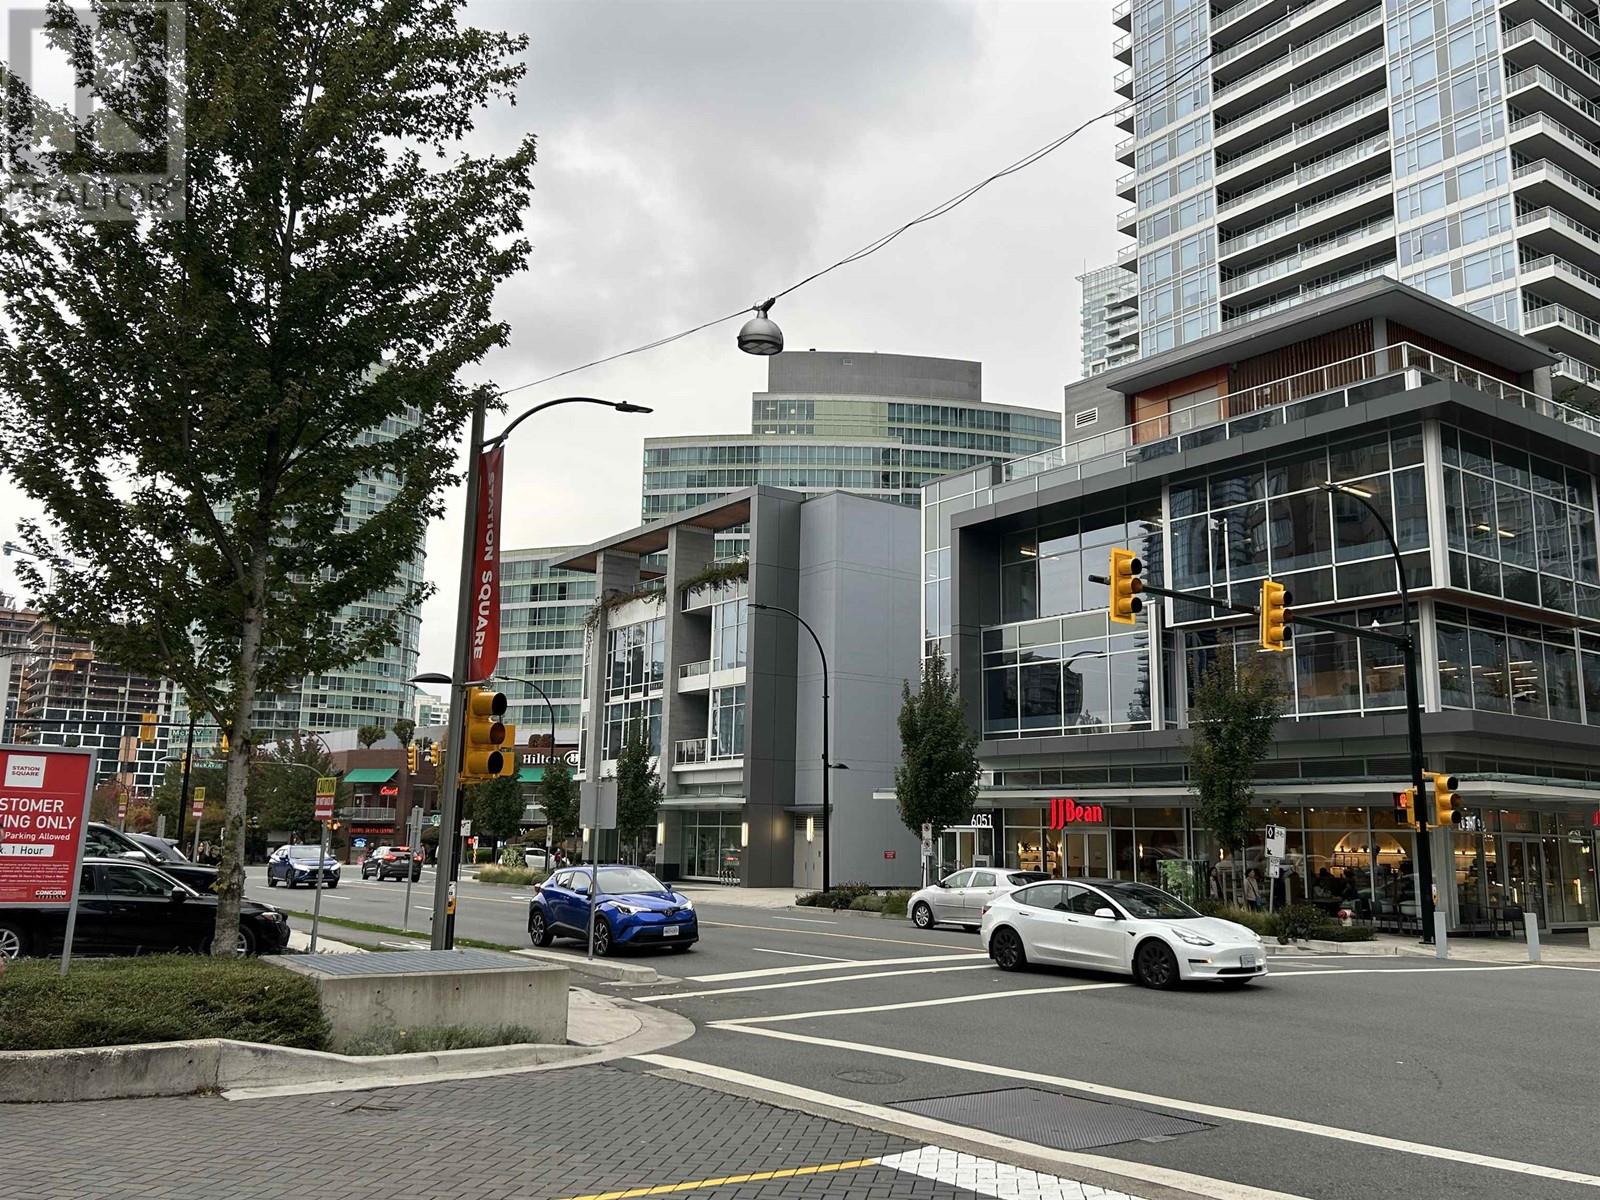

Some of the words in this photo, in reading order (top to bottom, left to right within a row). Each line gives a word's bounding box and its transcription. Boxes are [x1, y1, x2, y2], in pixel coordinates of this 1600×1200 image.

[484, 472, 494, 560] STATION
[474, 570, 492, 658] SQUARE
[0, 814, 30, 828] ING
[36, 816, 76, 830] ONLY
[970, 814, 992, 827] 6051
[4, 832, 36, 841] Parking
[38, 832, 70, 840] Allowed
[12, 846, 15, 854] 1
[20, 846, 44, 854] Hour
